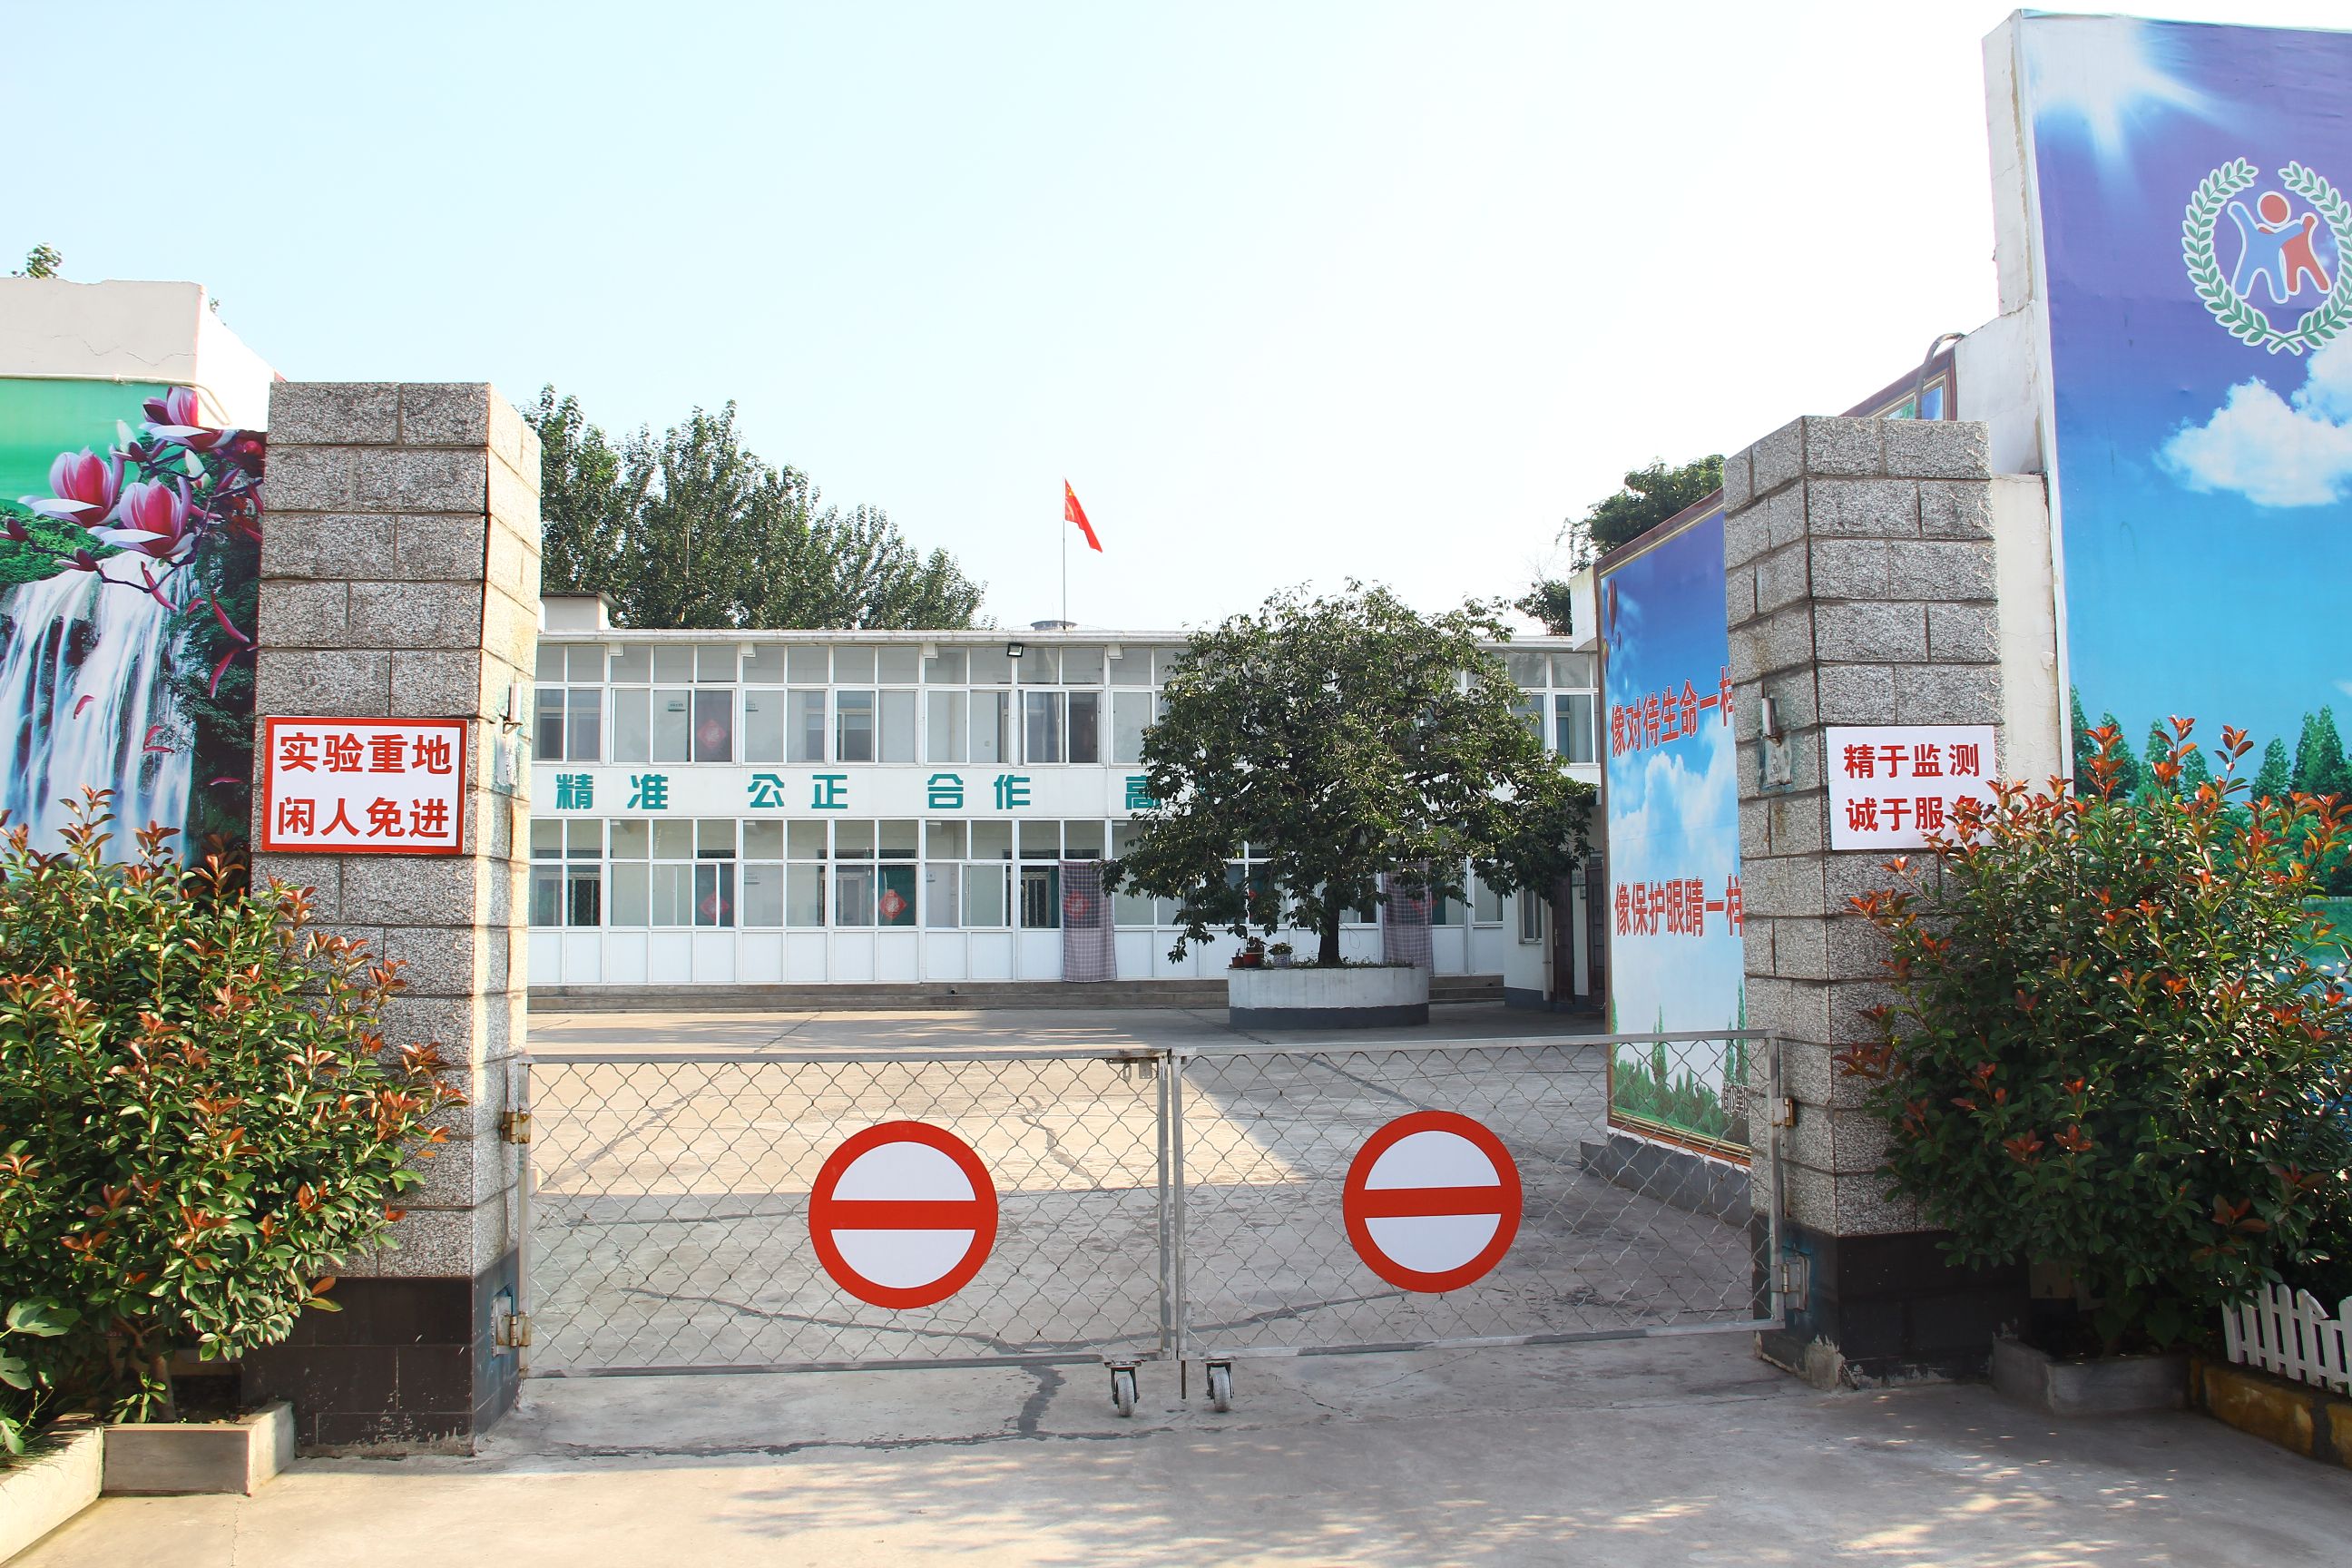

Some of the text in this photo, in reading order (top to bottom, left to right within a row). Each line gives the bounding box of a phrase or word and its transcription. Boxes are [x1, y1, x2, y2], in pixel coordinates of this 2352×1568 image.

[1610, 664, 1734, 758] 像对待生命一样
[279, 731, 454, 775] 实验重地
[1843, 743, 1980, 779] 精于监测
[554, 773, 669, 809] 精准
[747, 773, 848, 808] 公正
[926, 773, 1031, 809] 合作
[277, 796, 450, 838] 闲人免进
[1614, 874, 1742, 937] 像保护眼睛一样
